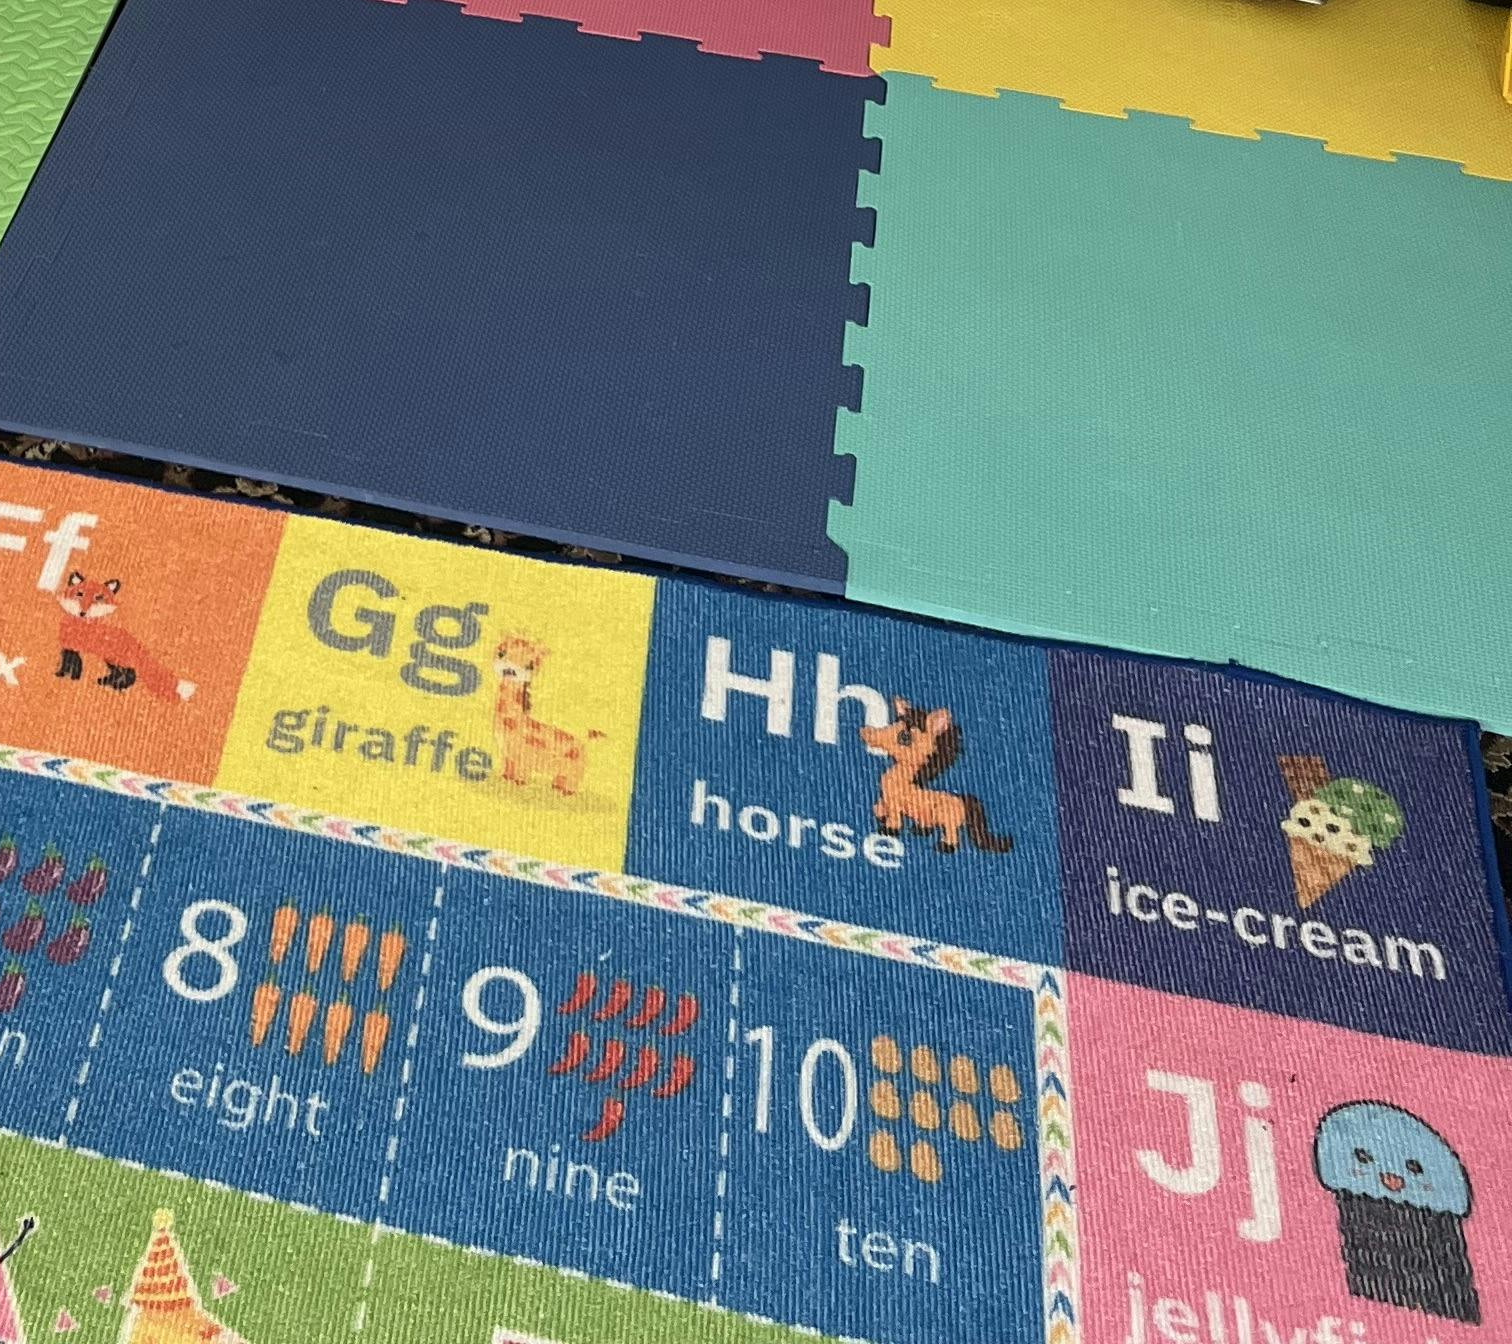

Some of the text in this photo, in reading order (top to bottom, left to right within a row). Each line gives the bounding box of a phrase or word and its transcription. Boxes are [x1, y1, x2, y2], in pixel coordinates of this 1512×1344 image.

[307, 569, 489, 697] Gg
[266, 705, 493, 783] giraffe
[701, 636, 890, 755] Hh
[1111, 714, 1221, 822] Ii
[691, 780, 905, 871] horse
[163, 899, 247, 1003] 8
[1106, 867, 1447, 981] ice-cream
[460, 966, 542, 1071] 9
[170, 1063, 329, 1140] eight
[743, 1025, 857, 1151] 10
[502, 1142, 641, 1212] nine
[1137, 1070, 1282, 1244] Jj
[835, 1218, 940, 1284] ten
